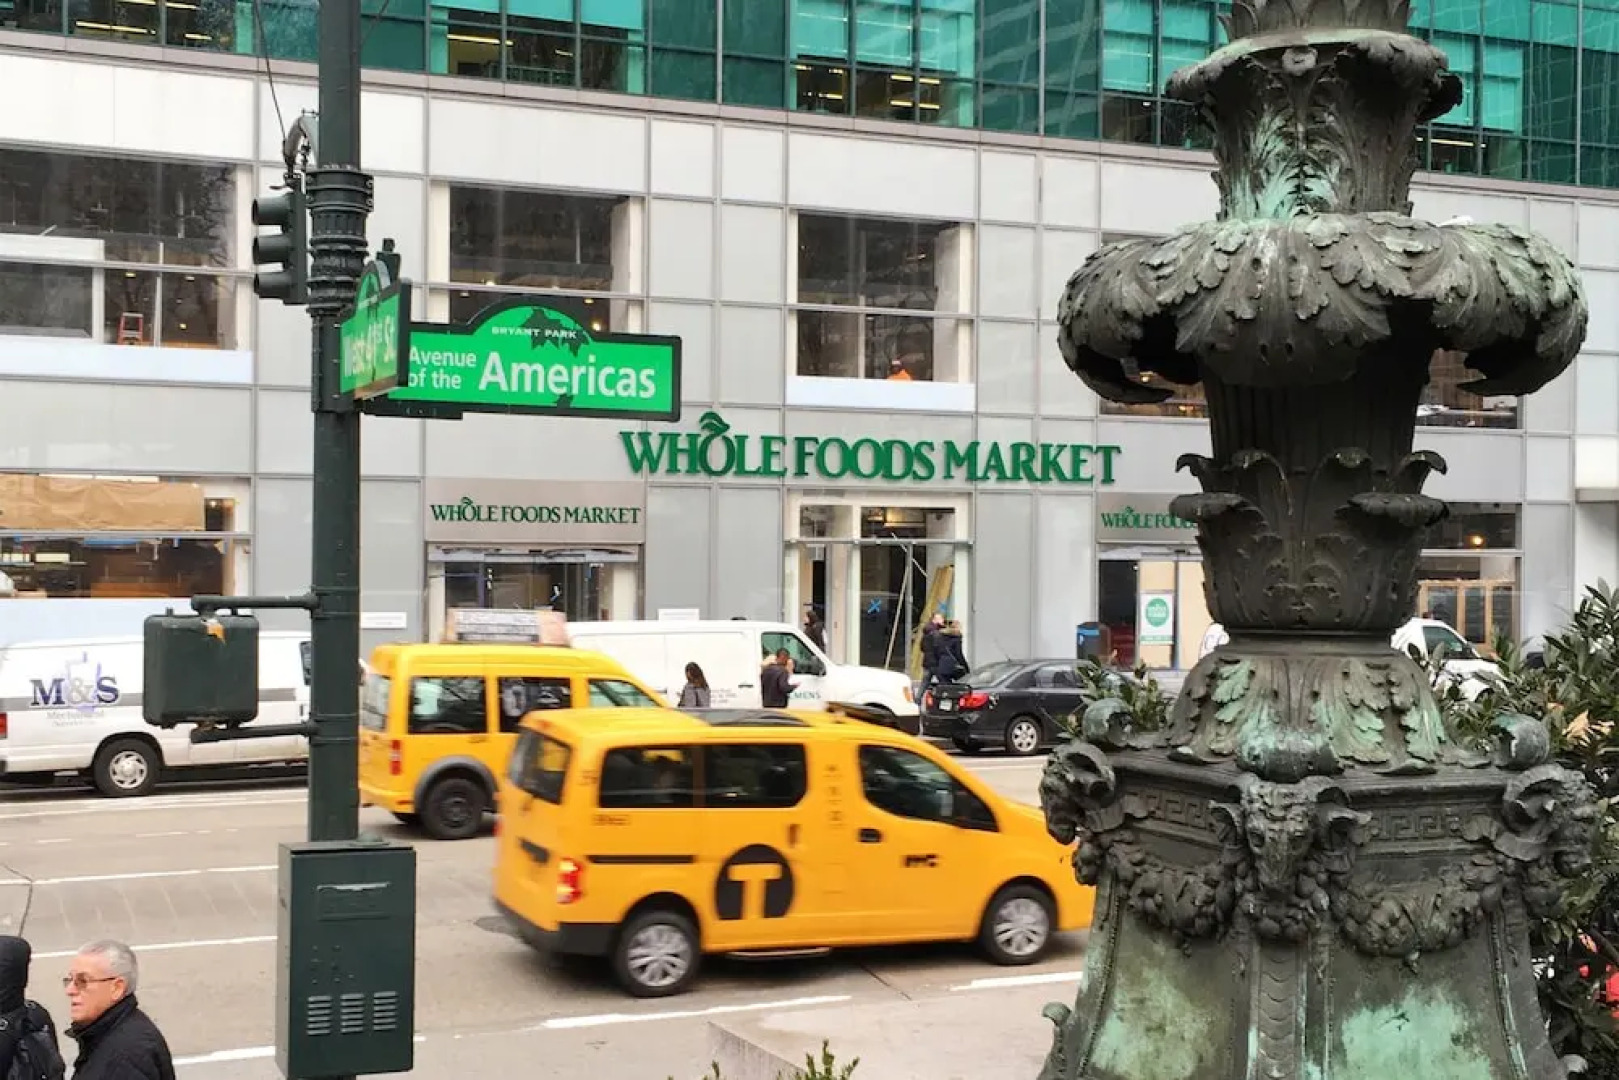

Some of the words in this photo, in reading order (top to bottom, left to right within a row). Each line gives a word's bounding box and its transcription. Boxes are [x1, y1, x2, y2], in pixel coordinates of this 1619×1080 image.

[492, 326, 540, 337] BRYANT
[545, 329, 577, 339] PARK
[408, 346, 477, 368] Avenue
[408, 369, 425, 388] of
[432, 369, 461, 389] the
[478, 353, 656, 399] Americas
[619, 428, 788, 477] WHOLE
[793, 436, 935, 480] FOODS
[942, 440, 1122, 484] MARKET
[431, 502, 498, 522] WHOLE
[501, 505, 561, 523] FOODS
[564, 506, 641, 524] MARKET
[1101, 511, 1152, 529] WHOLE
[30, 676, 119, 706] M&S
